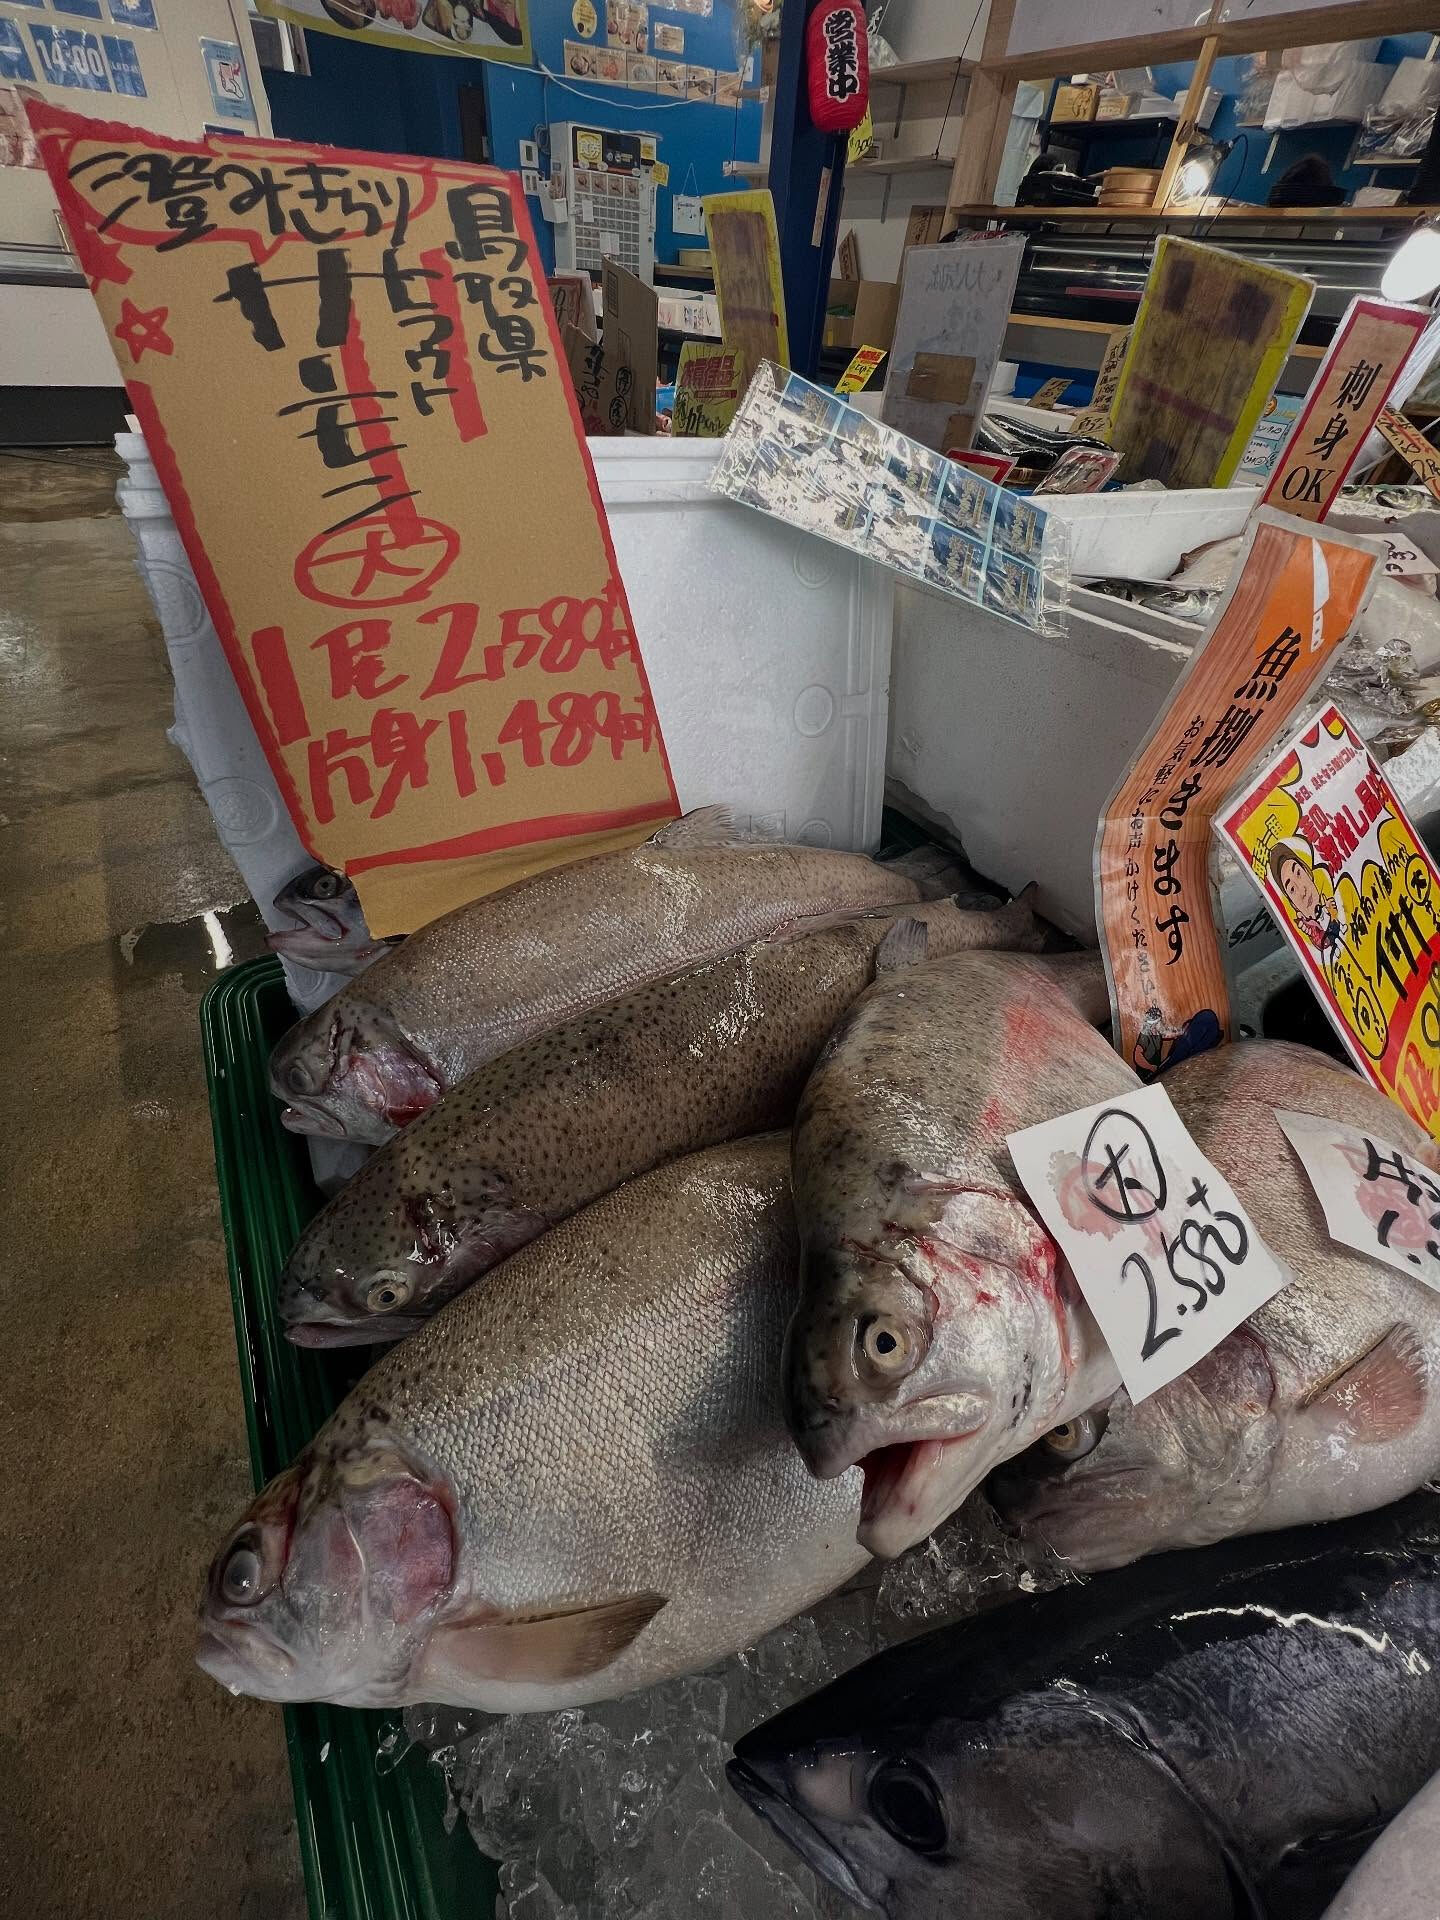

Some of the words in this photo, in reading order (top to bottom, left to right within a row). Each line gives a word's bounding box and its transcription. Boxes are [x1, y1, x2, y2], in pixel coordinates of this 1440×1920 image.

[36, 38, 104, 78] 14:00
[825, 9, 859, 100] 営業中
[446, 184, 547, 382] 鳥取県
[213, 248, 421, 533] サーモン
[1153, 626, 1301, 966] 魚捌きます
